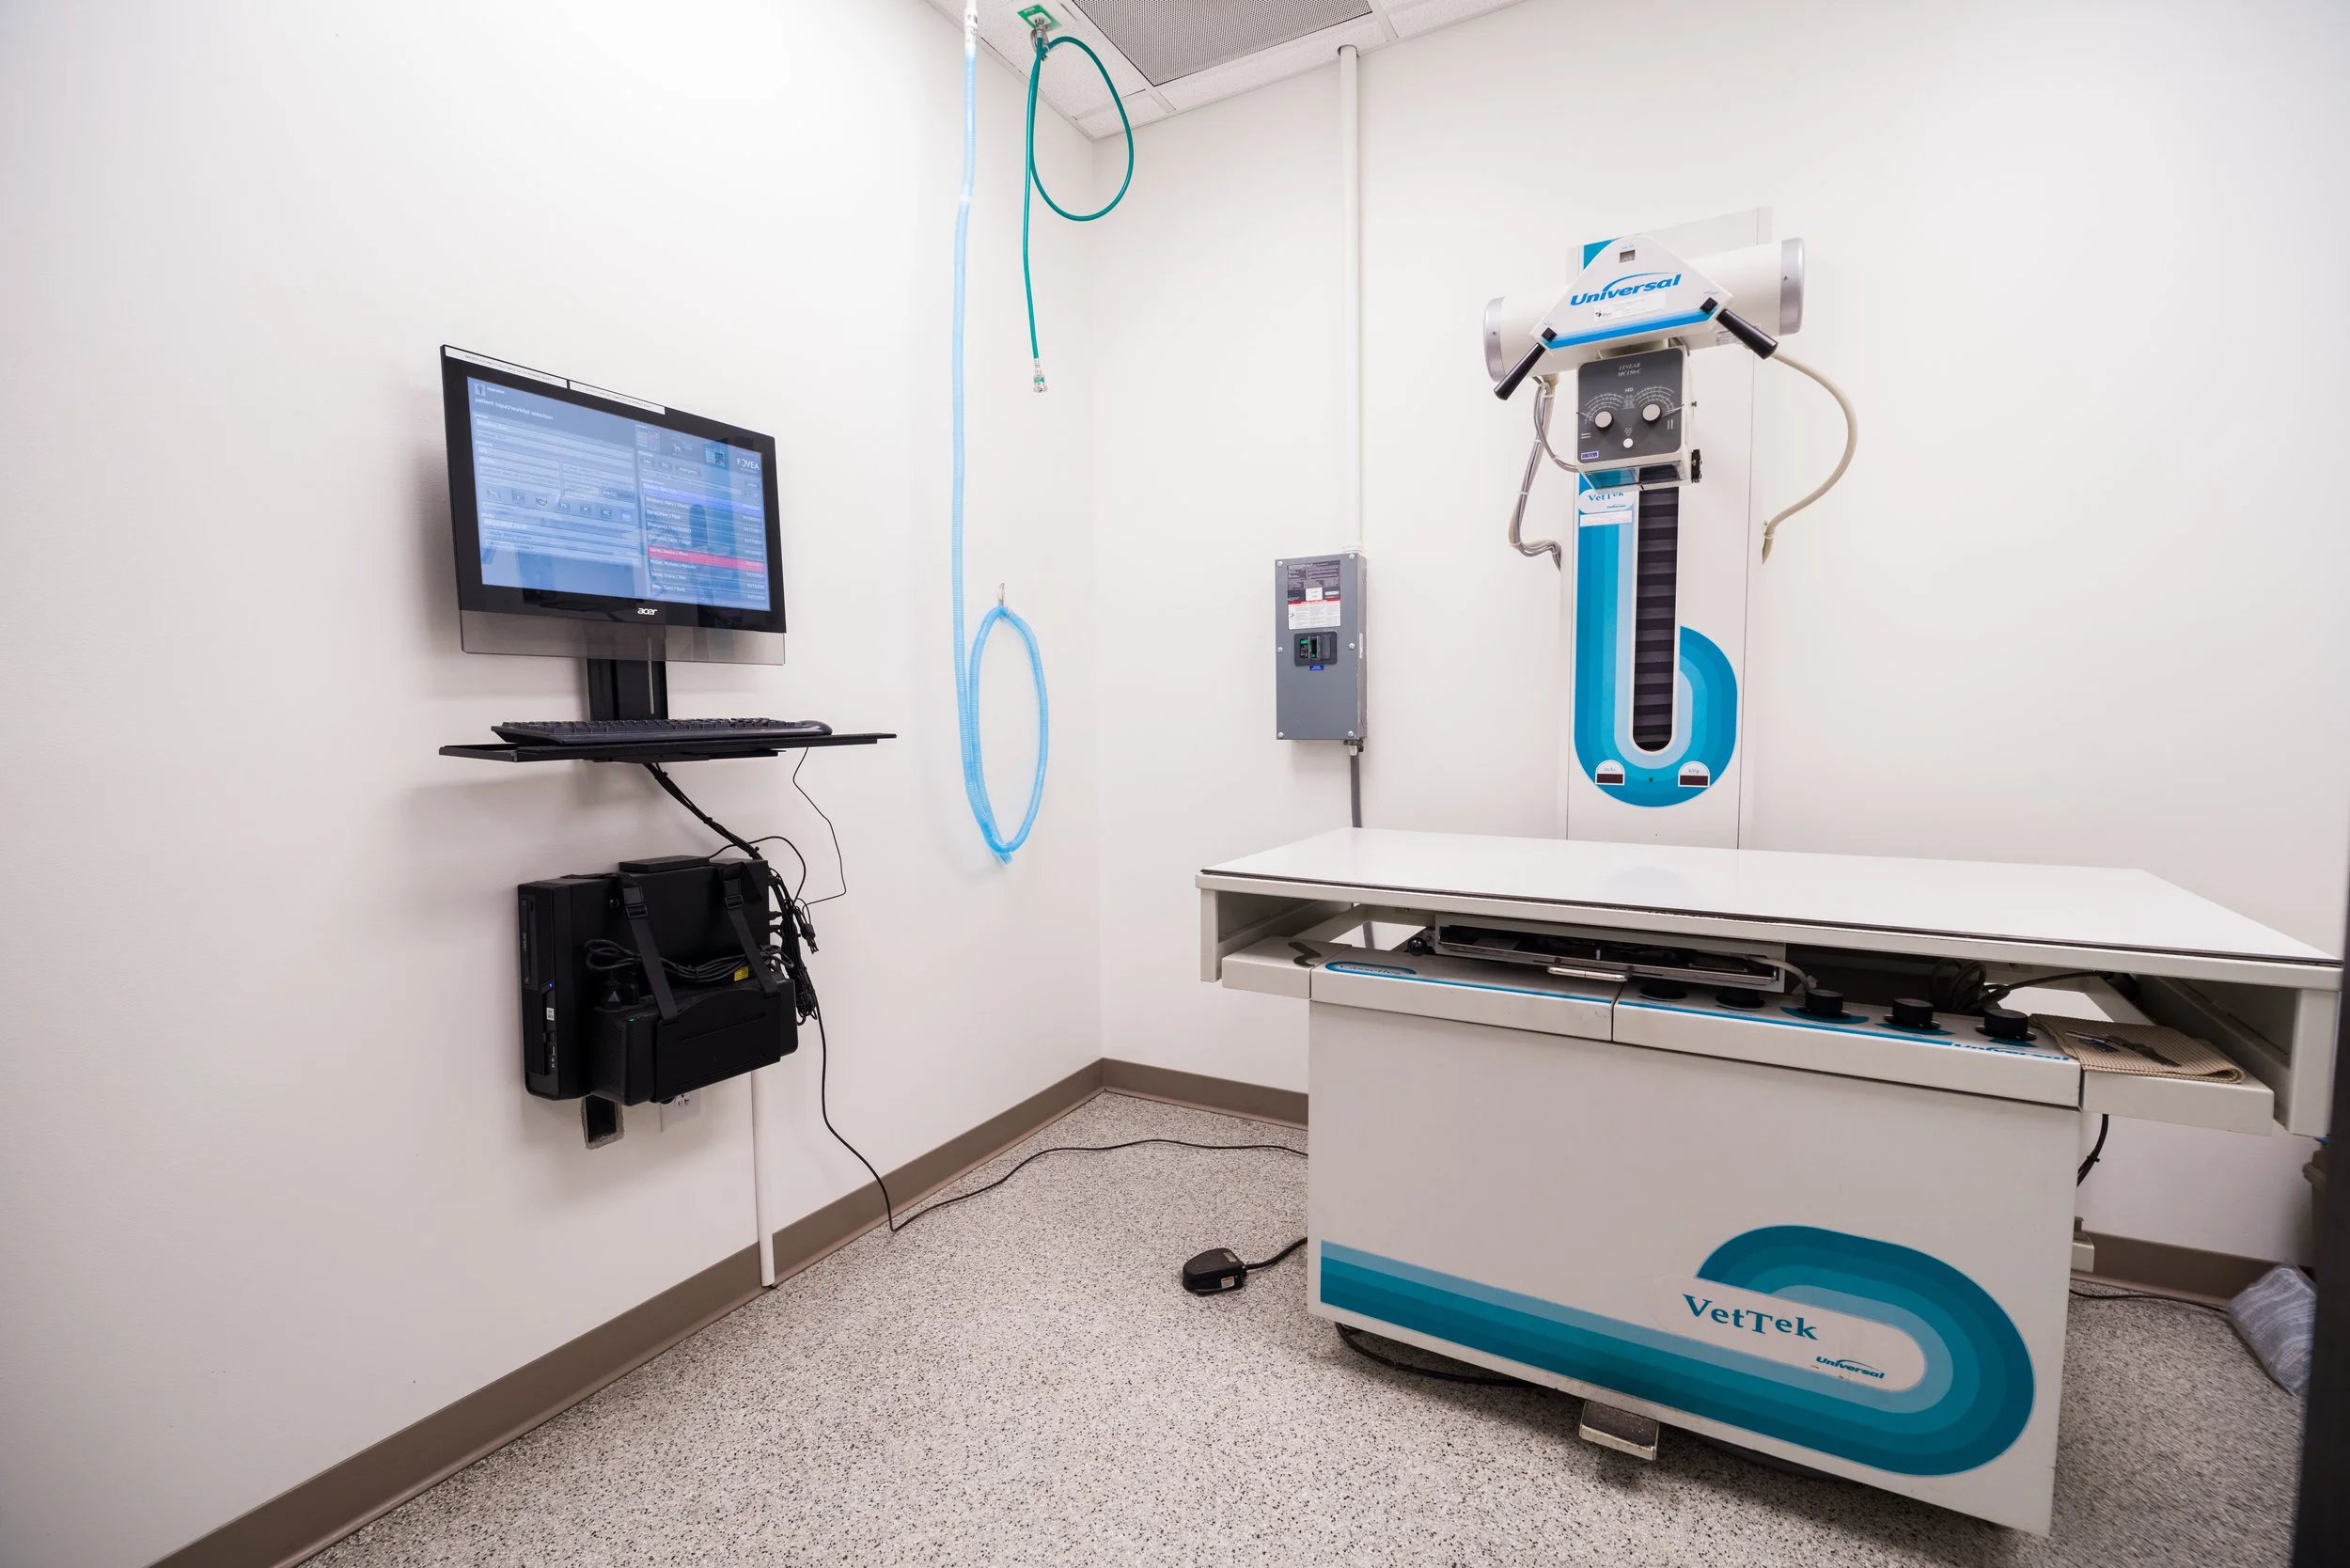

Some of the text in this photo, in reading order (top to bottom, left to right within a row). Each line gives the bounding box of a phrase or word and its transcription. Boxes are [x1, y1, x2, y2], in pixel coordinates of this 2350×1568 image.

[1570, 274, 1682, 306] Universal
[475, 398, 494, 406] patient
[531, 411, 554, 420] selection
[737, 458, 760, 470] FOVEA
[637, 607, 658, 616] acer
[1682, 1294, 1819, 1341] VetTek
[1816, 1356, 1886, 1379] Universal
